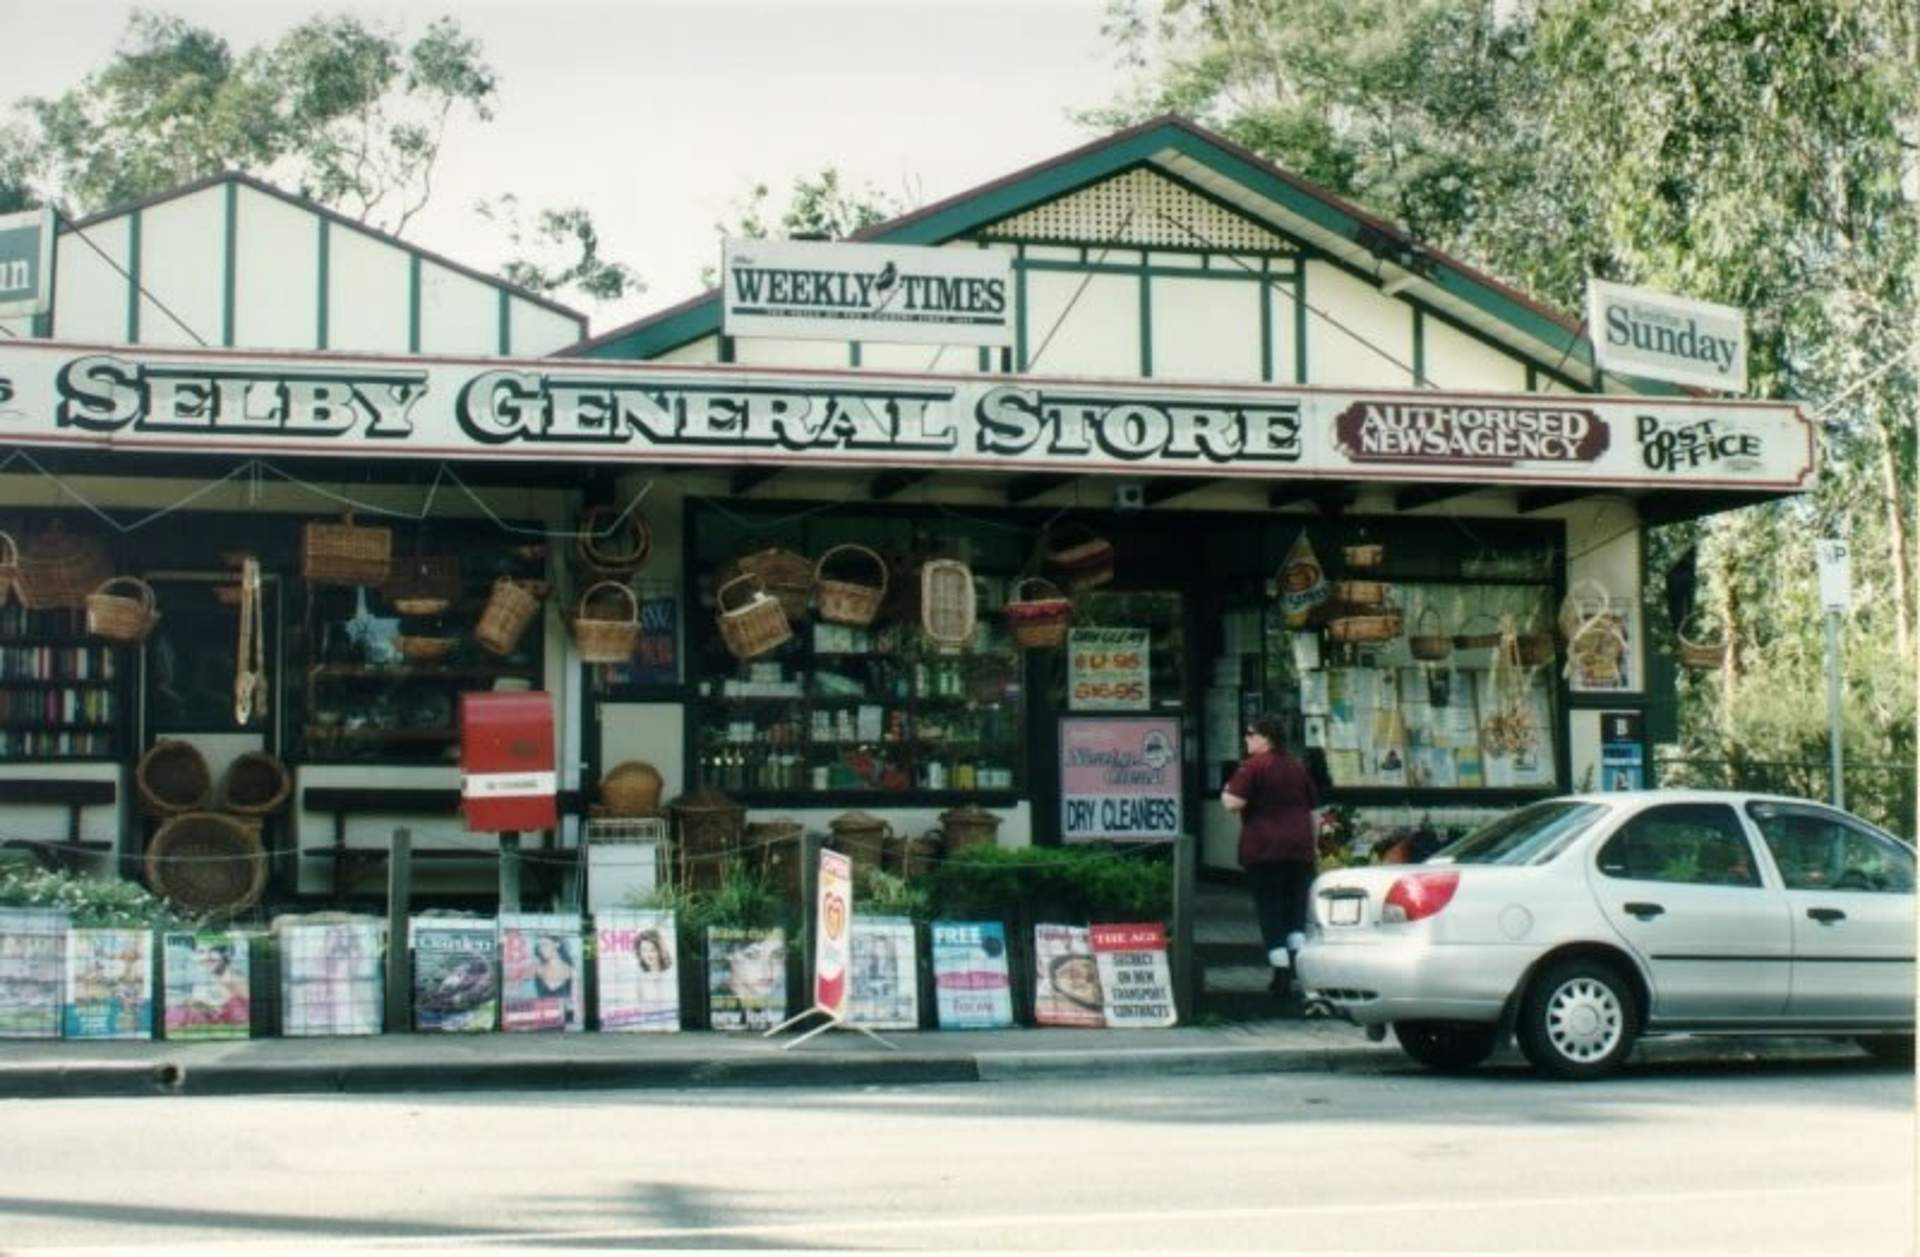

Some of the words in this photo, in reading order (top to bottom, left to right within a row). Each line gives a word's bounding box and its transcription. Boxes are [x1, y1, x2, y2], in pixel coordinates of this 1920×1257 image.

[732, 268, 876, 308] WEEKLY
[900, 275, 1006, 314] TIMES
[1606, 305, 1738, 373] Sunday
[57, 355, 428, 438] SELBY
[456, 369, 957, 451] GENERAL
[976, 385, 1301, 462] STORE
[1360, 405, 1590, 440] AUTHORISED
[1361, 429, 1583, 459] NEWSAGENCY
[1636, 416, 1717, 451] POST
[1643, 434, 1763, 471] OFFICE
[1067, 799, 1095, 831] DRY
[1102, 797, 1176, 831] CLEANERS
[934, 926, 981, 944] FREE
[1095, 932, 1127, 944] THE
[1132, 931, 1158, 942] AGE
